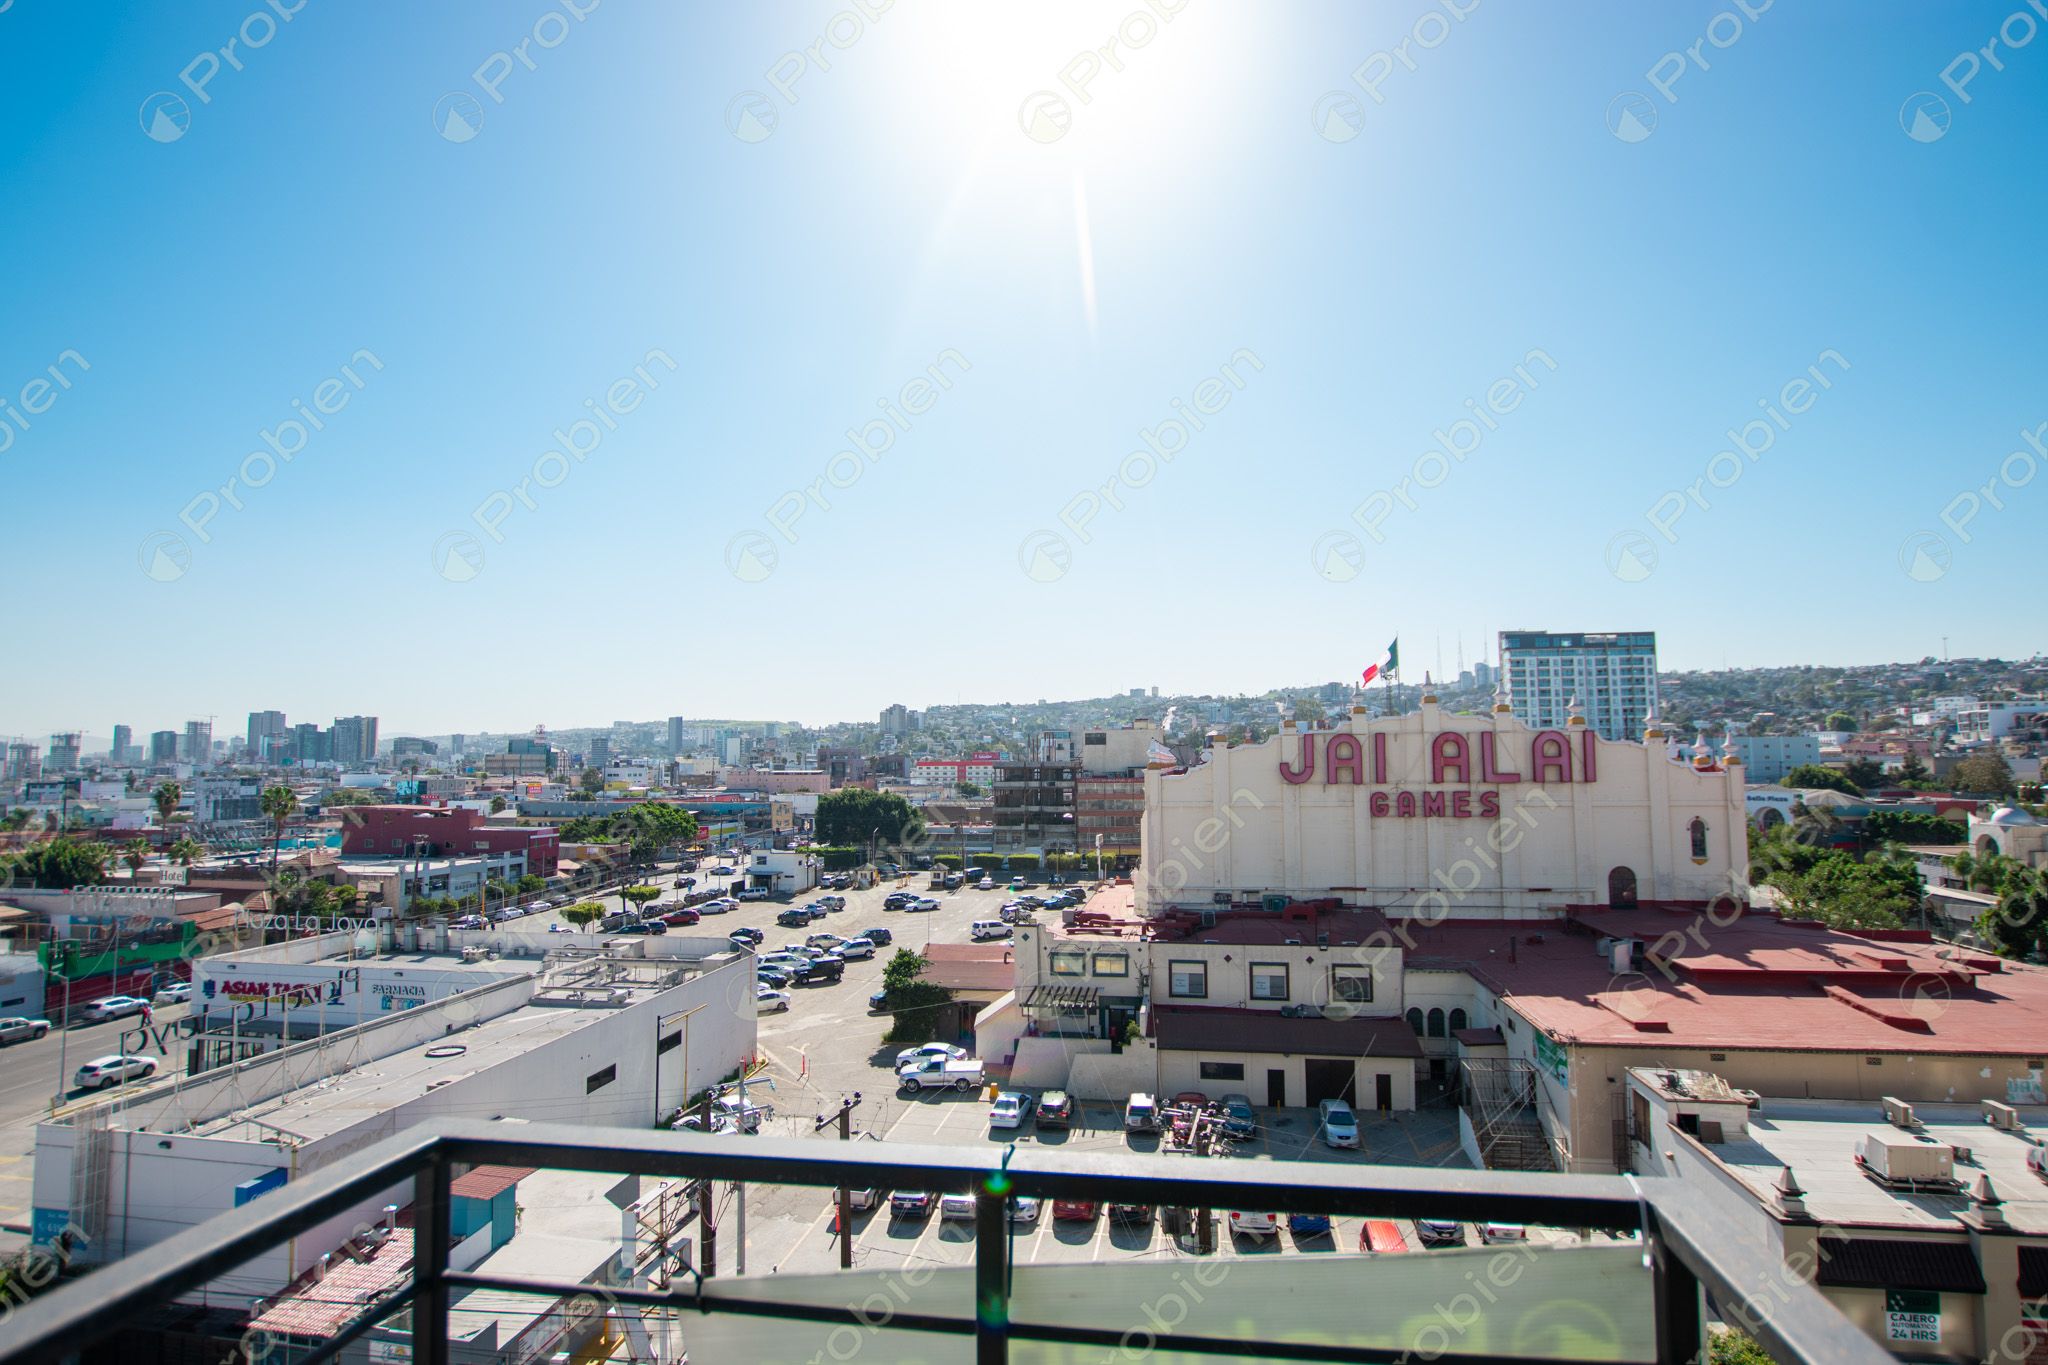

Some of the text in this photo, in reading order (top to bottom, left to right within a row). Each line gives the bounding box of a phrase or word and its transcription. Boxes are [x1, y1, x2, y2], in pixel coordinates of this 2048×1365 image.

[1279, 730, 1596, 785] JAI ALAI
[1370, 790, 1499, 818] GAMES
[161, 870, 185, 882] Hotel
[234, 909, 378, 937] Plaza La Joya
[221, 980, 270, 996] ASIAN
[372, 984, 425, 996] FARMACIA
[1890, 1313, 1937, 1324] CAJERO
[1891, 1329, 1938, 1341] 24 HRS
